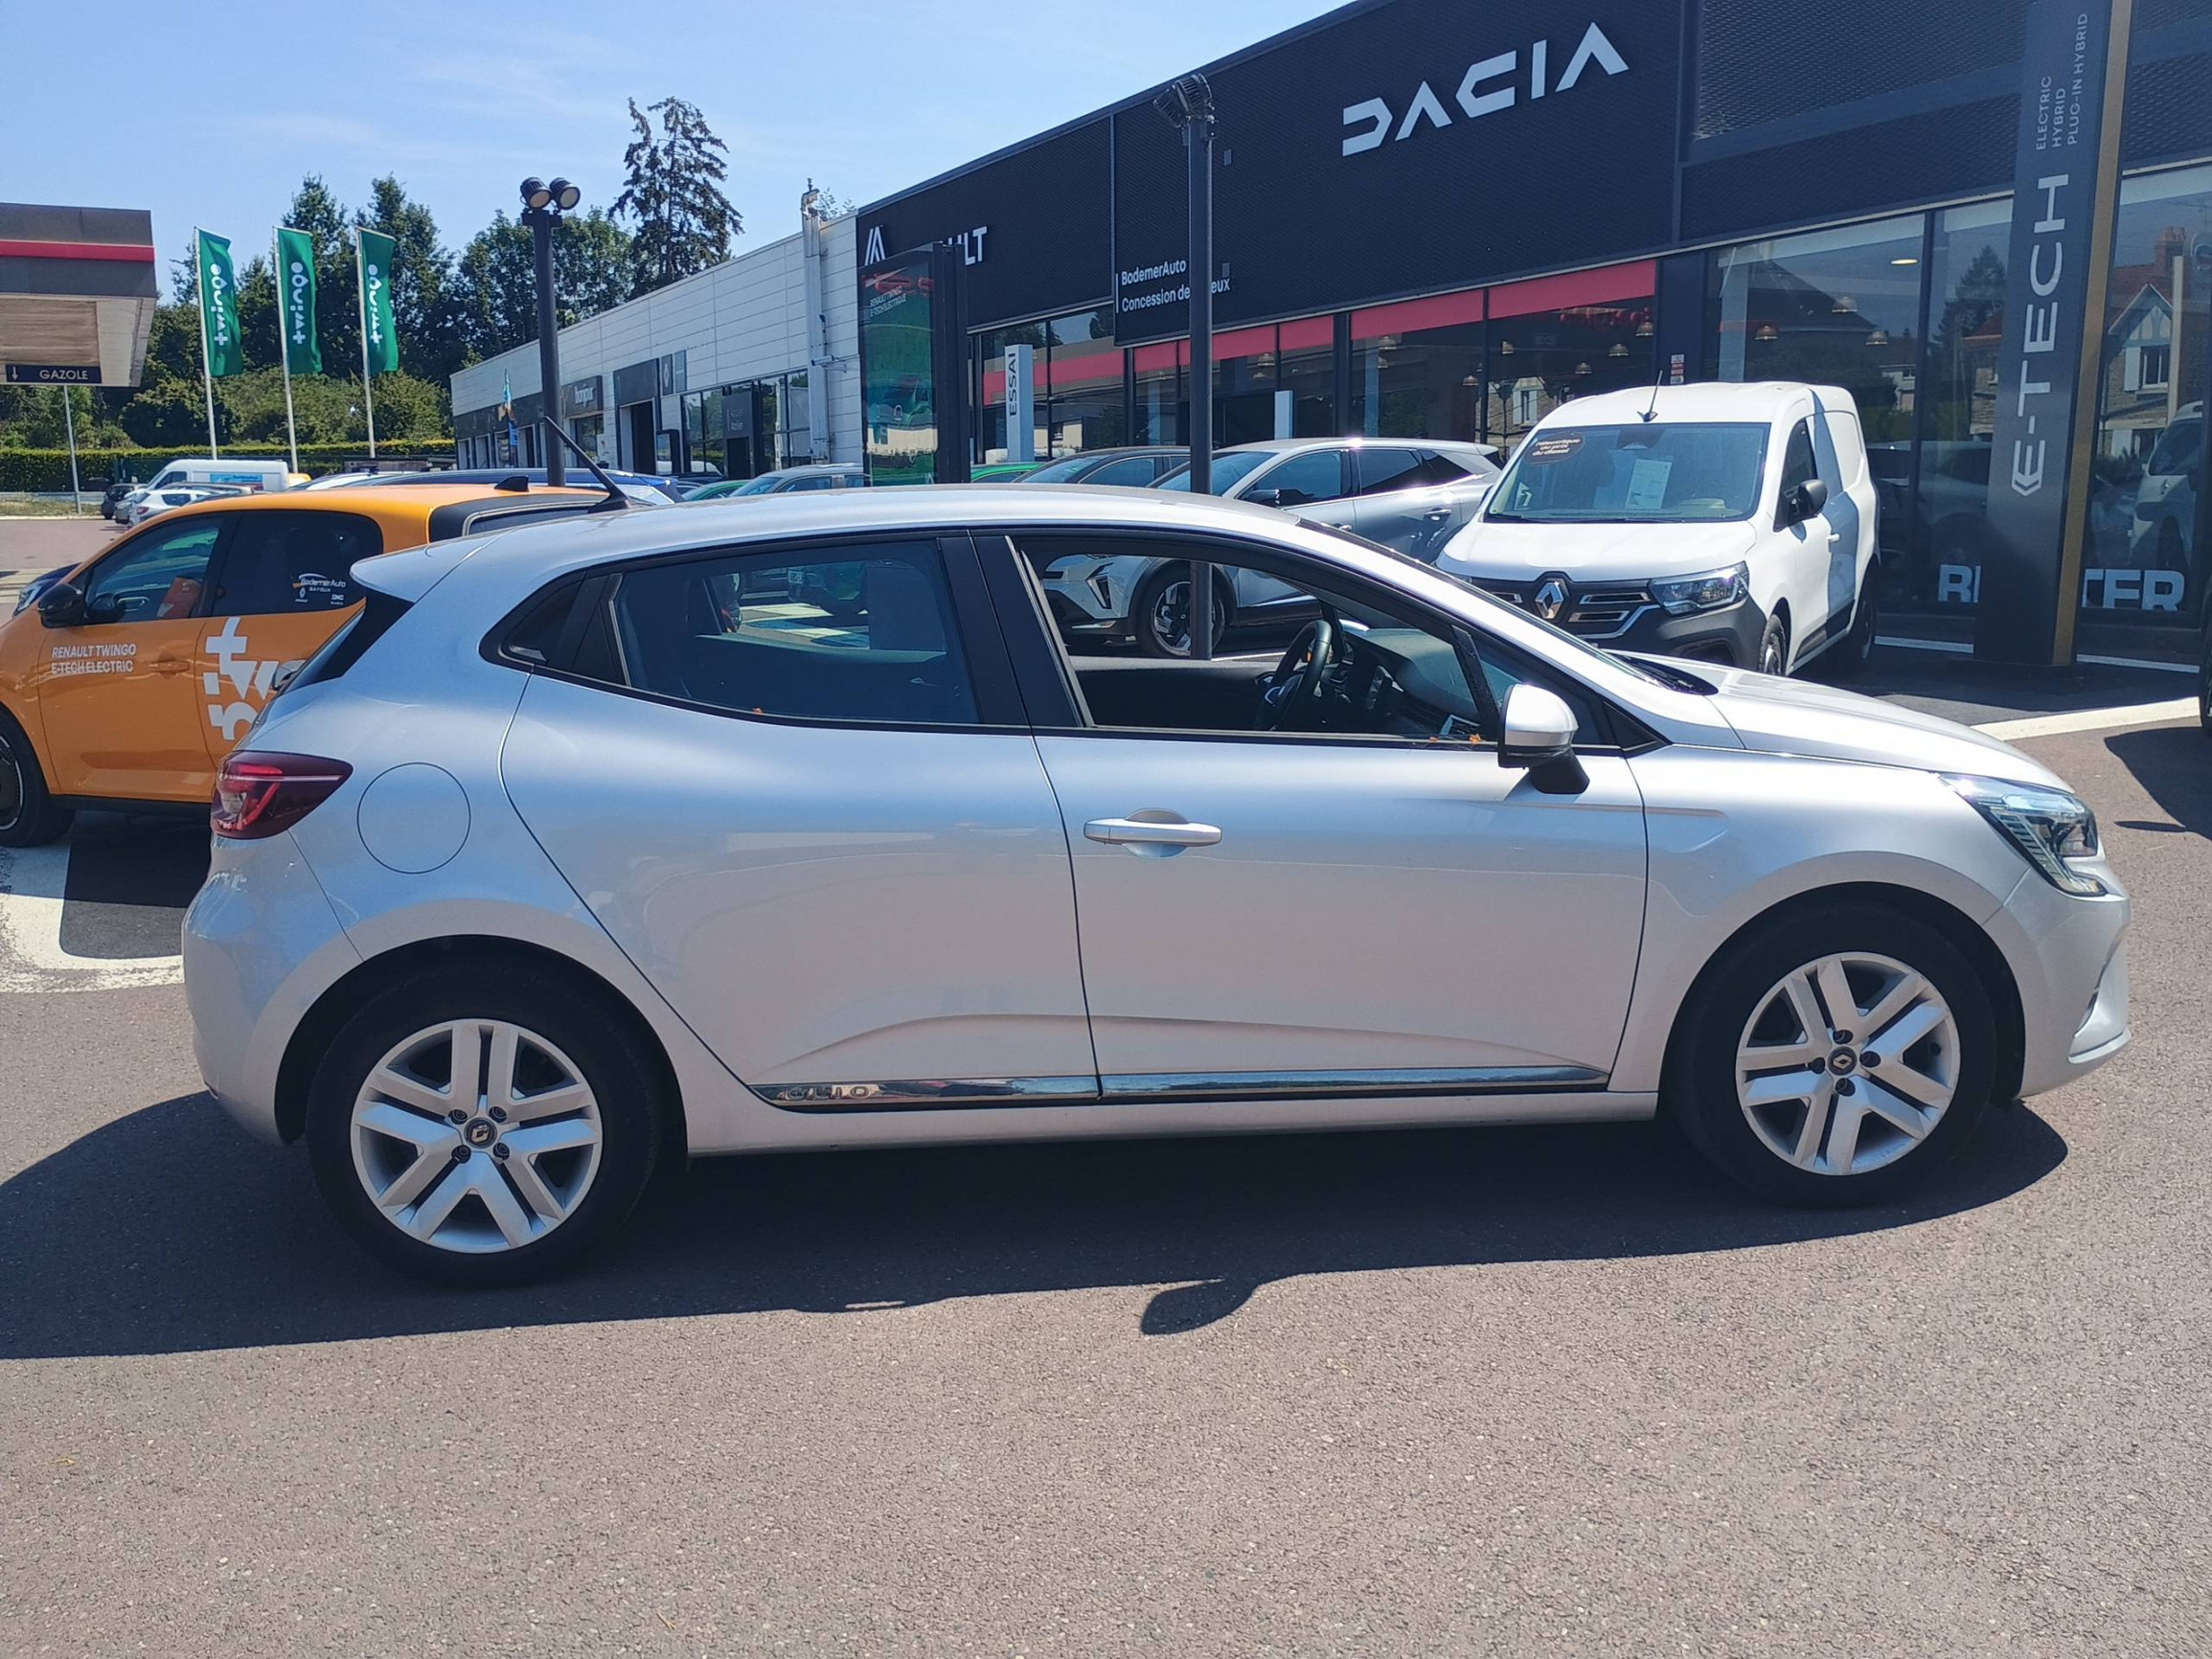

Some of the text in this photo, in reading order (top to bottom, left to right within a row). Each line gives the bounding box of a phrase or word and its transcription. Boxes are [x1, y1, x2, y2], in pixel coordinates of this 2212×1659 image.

[1342, 22, 1630, 156] DACIA
[2067, 12, 2088, 145] PLUG-IN HYBRID
[2036, 76, 2052, 150] ELECTRIC
[2052, 87, 2066, 148] HYBRID
[1121, 260, 1187, 285] BodemerAuto
[1121, 288, 1176, 312] Concession
[1176, 284, 1191, 301] de
[2012, 174, 2069, 496] E-TECH
[39, 370, 88, 380] GAZOLE
[1008, 352, 1017, 416] ESSAI
[52, 643, 136, 658] RENAULT TWINGO
[85, 660, 134, 673] ELECTRIC
